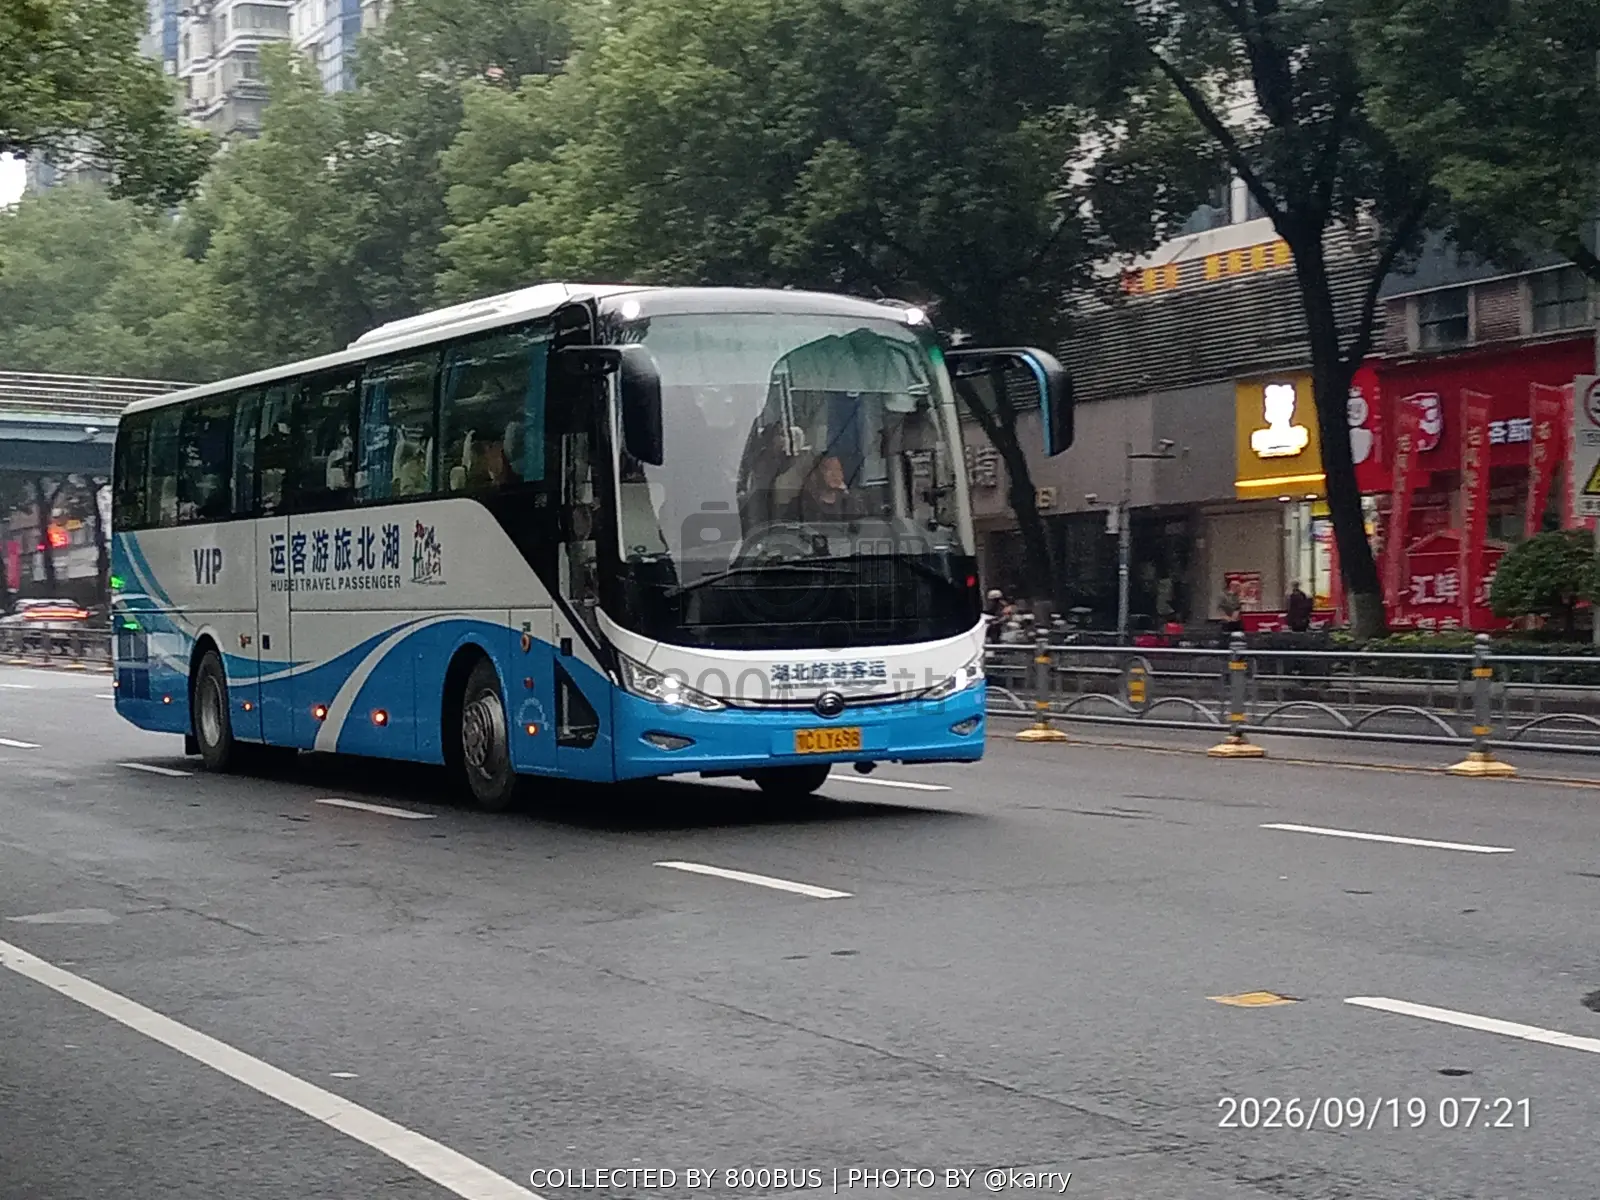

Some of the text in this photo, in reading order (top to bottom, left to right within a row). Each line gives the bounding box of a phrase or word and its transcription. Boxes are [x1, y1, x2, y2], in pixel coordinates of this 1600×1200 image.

[193, 548, 223, 585] VIP
[270, 575, 400, 592] HUBEI TRAVEL PASSENGER
[770, 660, 887, 682] 湖北旅游客运
